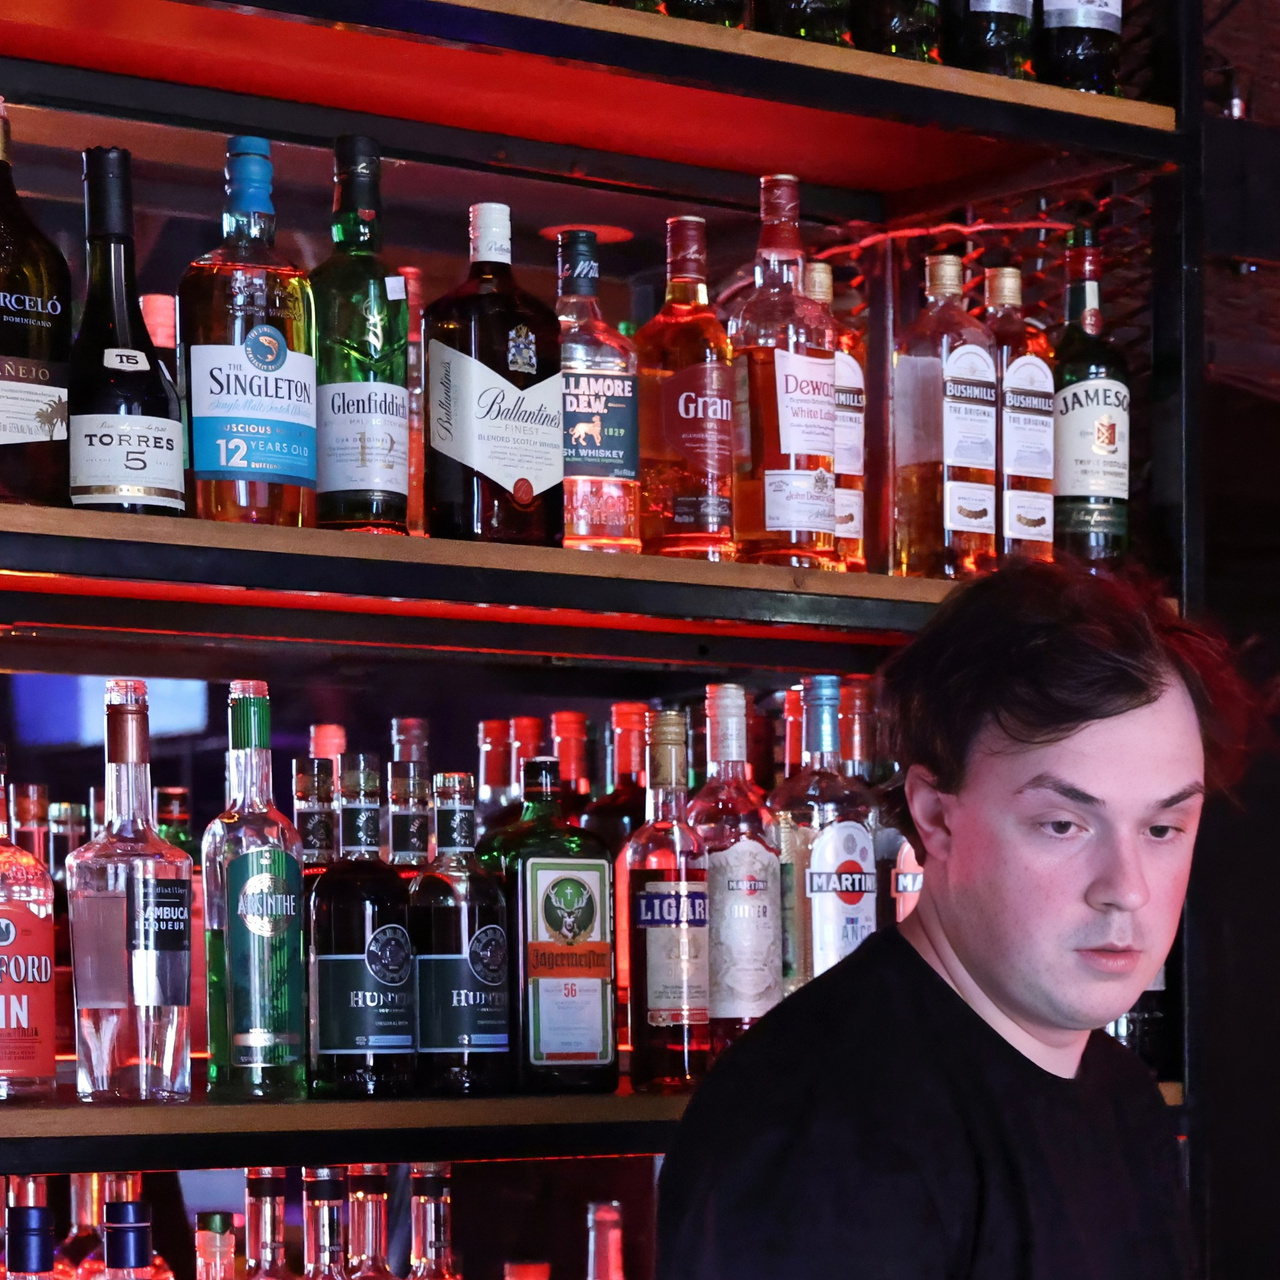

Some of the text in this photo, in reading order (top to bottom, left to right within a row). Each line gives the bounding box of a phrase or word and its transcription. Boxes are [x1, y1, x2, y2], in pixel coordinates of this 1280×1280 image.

[3, 315, 52, 328] DOMINICANO
[0, 361, 50, 380] ÑEJO
[209, 367, 313, 405] SINGLETON
[946, 382, 996, 402] BUSHMILLS
[331, 391, 407, 420] Glenfiddich
[1005, 393, 1054, 412] BUSHMILLS
[475, 387, 562, 439] Ballantine's
[477, 433, 511, 444] BLENDED
[512, 437, 538, 446] SCOTCH
[504, 424, 540, 436] FINEST
[84, 433, 175, 451] TORRES
[250, 441, 288, 454] YEARS
[124, 450, 147, 471] 5
[216, 438, 248, 469] 12
[578, 449, 625, 459] WHISKEY
[563, 983, 577, 997] 56
